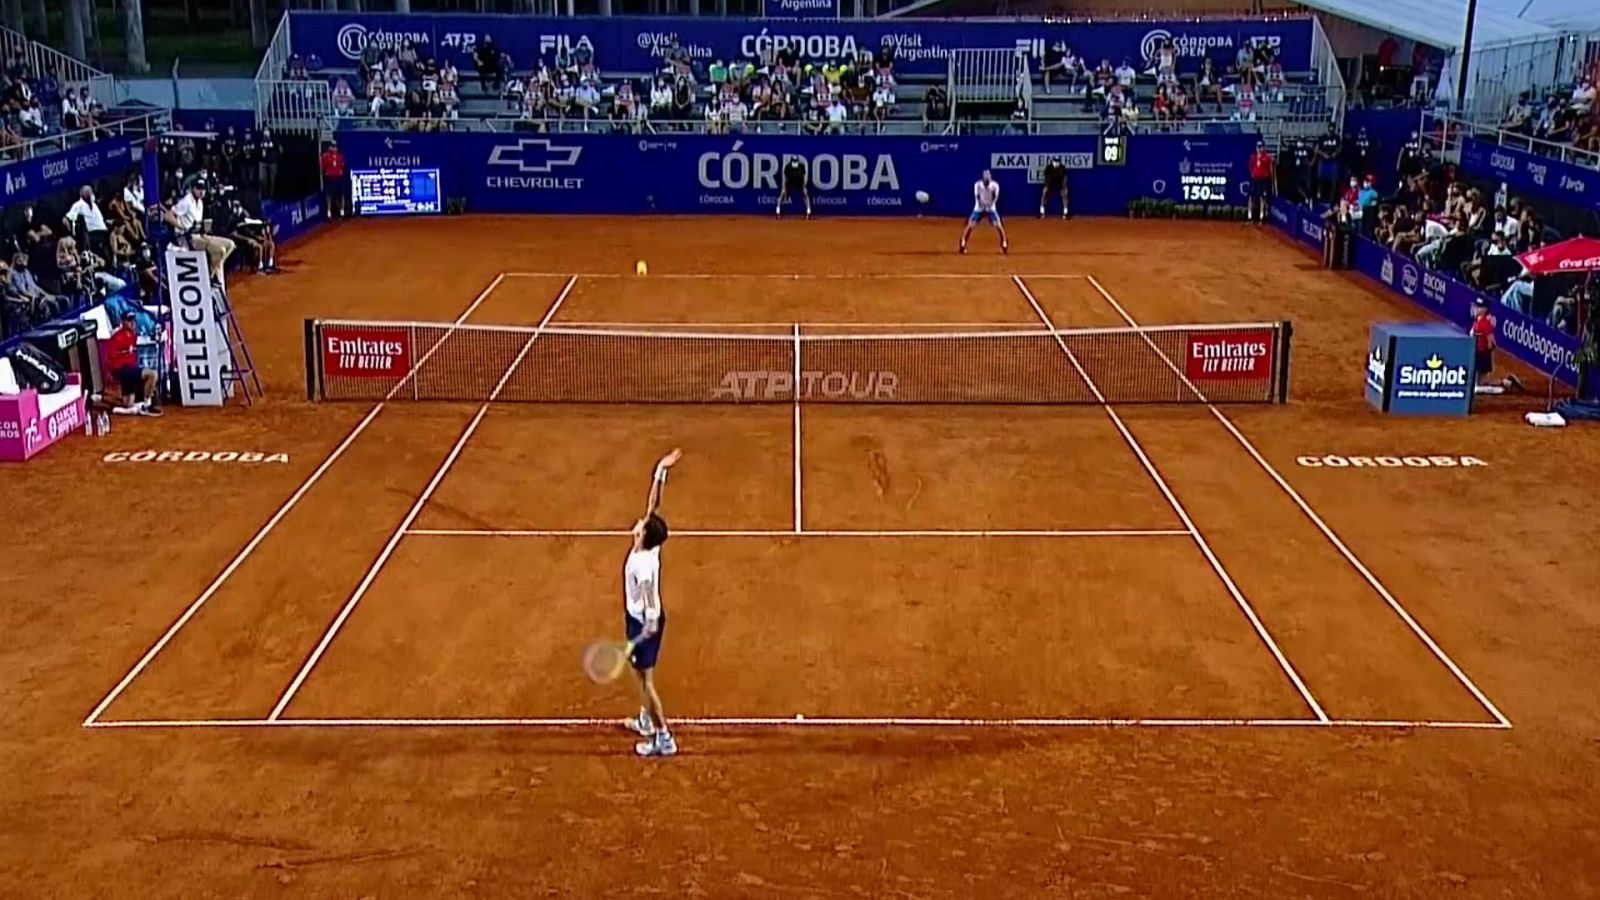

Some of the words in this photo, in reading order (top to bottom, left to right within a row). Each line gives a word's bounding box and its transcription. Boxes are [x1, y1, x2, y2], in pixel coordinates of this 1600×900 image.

[441, 33, 476, 47] ATP
[540, 35, 595, 54] FILA
[1172, 33, 1233, 47] CÓRDOBA
[368, 155, 420, 167] HITACHI
[996, 155, 1030, 167] AKAI
[486, 176, 585, 189] CHEVROLET
[1181, 176, 1203, 184] SERVE
[1204, 176, 1227, 185] SPEED
[1183, 185, 1211, 200] 150
[175, 256, 212, 400] TELECOM
[328, 336, 403, 355] Emirates
[1193, 340, 1267, 359] Emirates
[16, 349, 60, 382] HEAD
[339, 354, 356, 369] FLY
[358, 355, 392, 369] BETTER
[1203, 358, 1220, 373] FLY
[1221, 357, 1256, 372] BETTER
[713, 370, 793, 401] ATP
[801, 370, 900, 401] TOUR
[1399, 365, 1467, 391] Simplot
